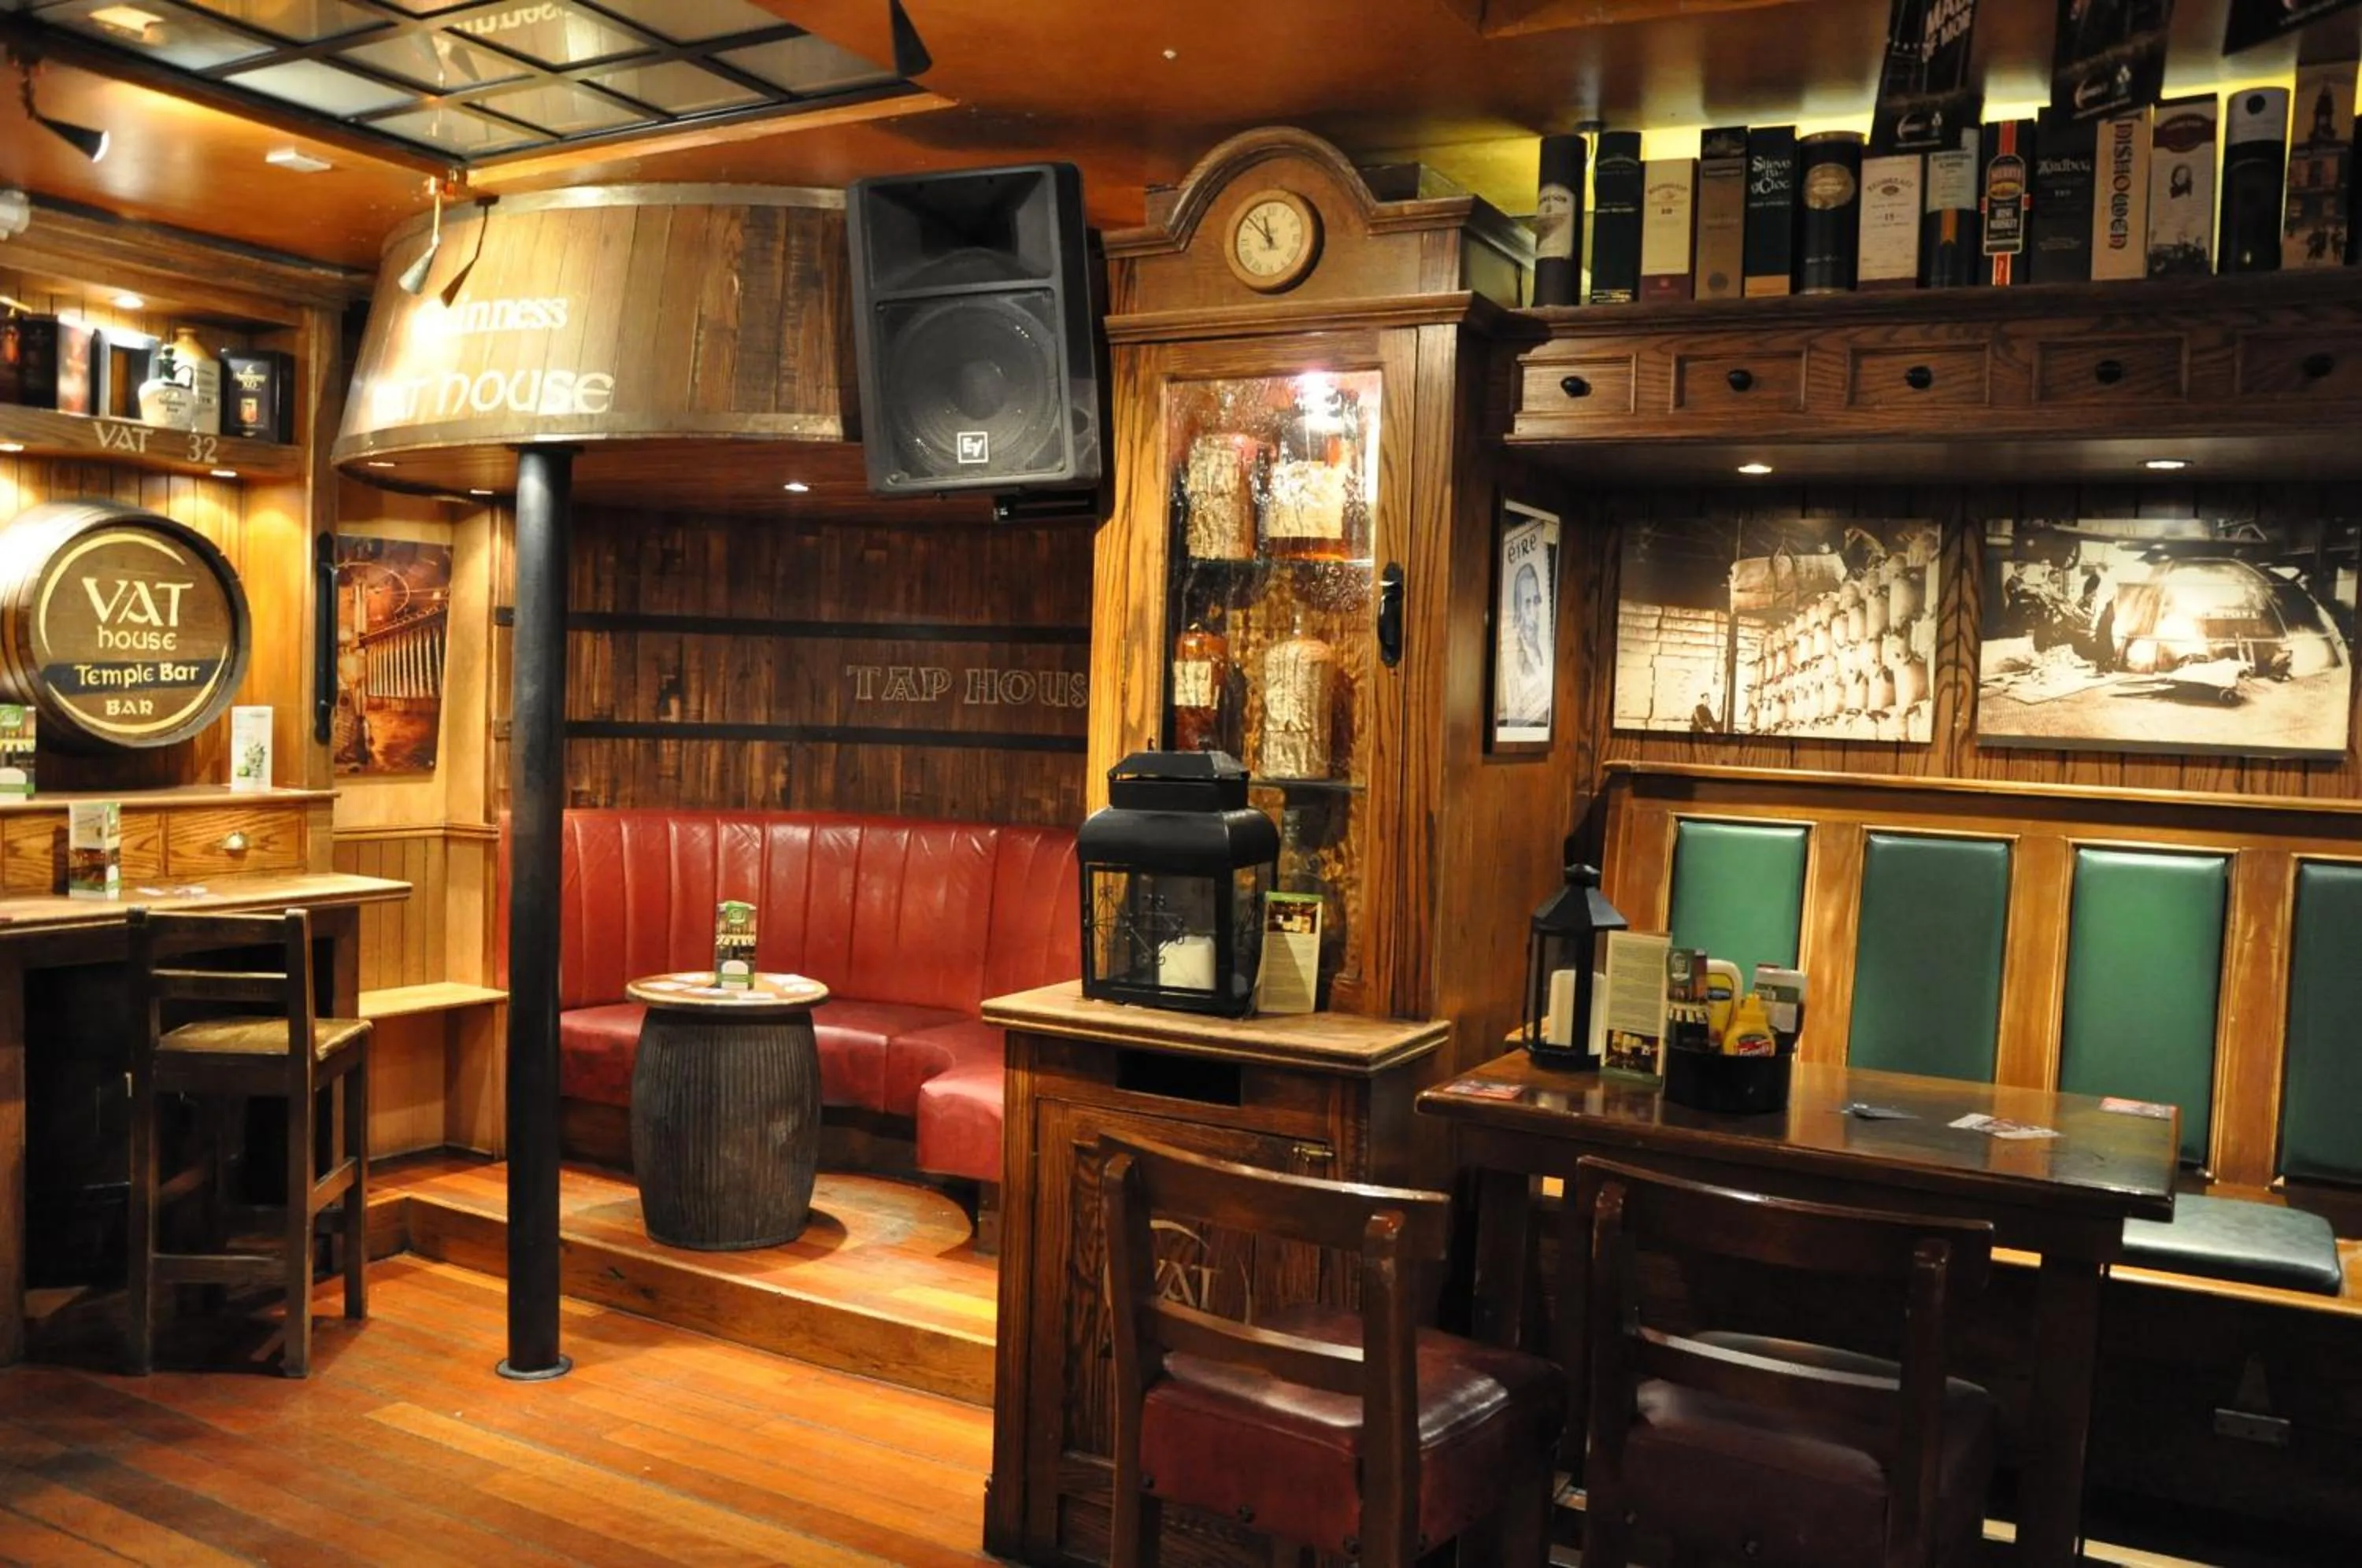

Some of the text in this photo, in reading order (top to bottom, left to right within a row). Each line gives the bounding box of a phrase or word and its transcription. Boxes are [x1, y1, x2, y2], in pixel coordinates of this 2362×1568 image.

[416, 292, 568, 337] inness
[93, 421, 219, 464] VAT 32
[81, 576, 194, 627] VAT
[75, 662, 200, 689] Temple Bar
[846, 664, 1088, 708] TAP HOUS
[105, 700, 154, 716] BAR
